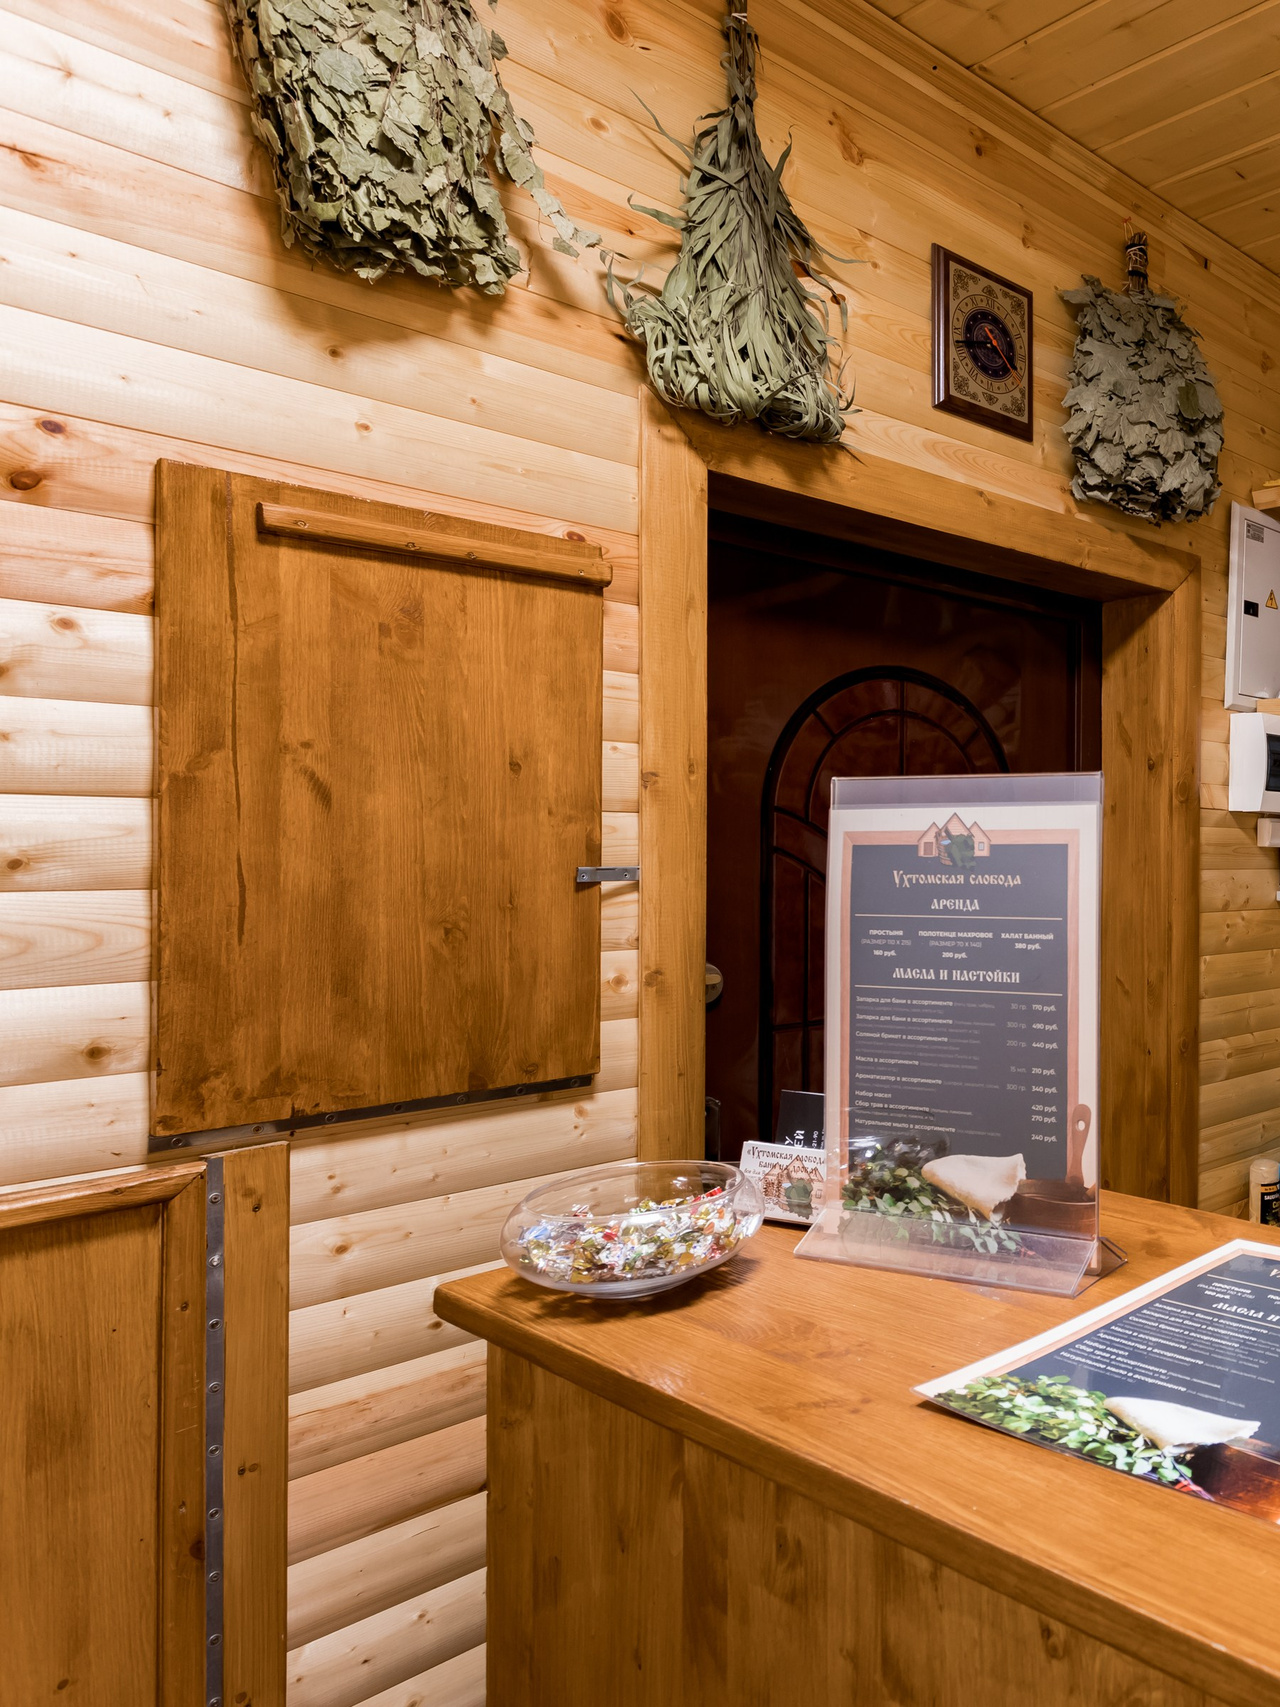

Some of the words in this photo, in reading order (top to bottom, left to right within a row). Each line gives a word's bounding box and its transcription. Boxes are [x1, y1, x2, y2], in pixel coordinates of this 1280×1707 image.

[892, 869, 965, 889] Ухтомская
[969, 873, 1022, 888] слобода
[930, 898, 980, 912] АРЕНДА
[868, 929, 904, 937] ПРОСТЫНЯ
[918, 930, 957, 939] ПОЛОТЕНЦЕ
[957, 931, 994, 939] МАХРОВОЕ
[1000, 932, 1024, 940] ХАЛАТ
[1024, 932, 1054, 940] БАННЫЙ
[892, 967, 936, 981] МАСЛА
[939, 968, 949, 981] И
[951, 968, 1021, 984] НАСТОЙКИ
[1045, 1023, 1059, 1031] руб.
[1045, 1042, 1059, 1050] руб.
[1044, 1086, 1058, 1094] руб.
[854, 1090, 874, 1098] Набор
[1044, 1105, 1058, 1113] руб.
[1044, 1135, 1058, 1143] руб.
[1212, 1302, 1265, 1319] МАСЛА
